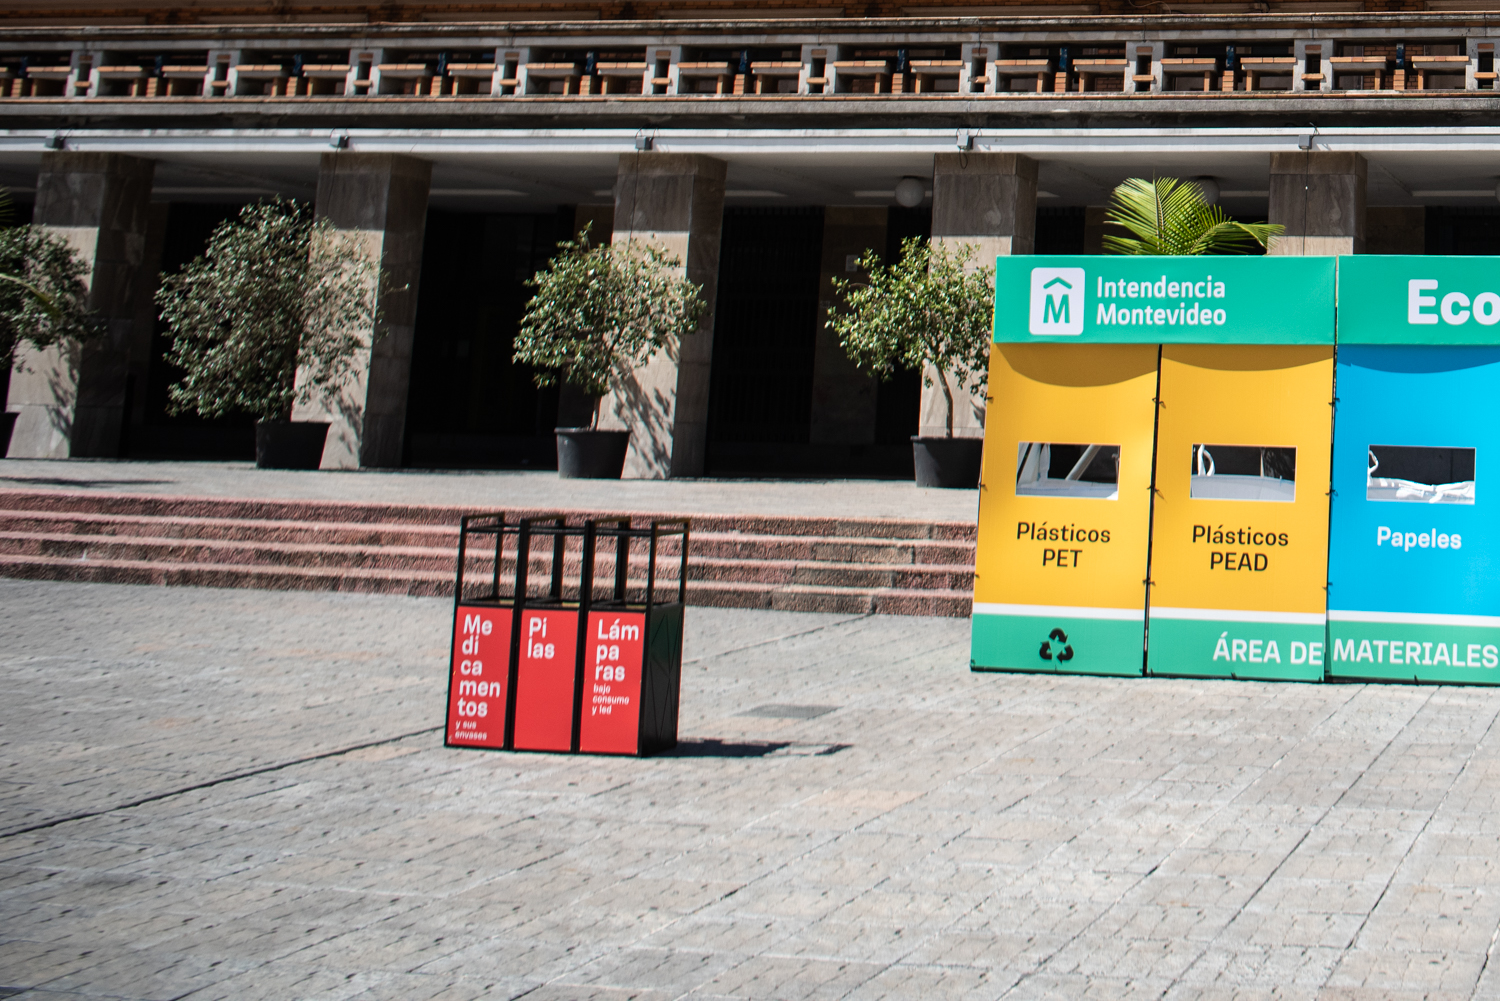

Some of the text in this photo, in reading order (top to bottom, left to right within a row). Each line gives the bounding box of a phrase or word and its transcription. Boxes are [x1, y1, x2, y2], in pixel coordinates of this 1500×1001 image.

[1096, 275, 1226, 301] Intendencia
[1096, 302, 1227, 327] Montevideo
[1015, 520, 1112, 545] Plásticos
[1191, 524, 1290, 548] Plásticos
[1376, 525, 1463, 552] Papeles
[1041, 549, 1083, 569] PET
[1209, 551, 1269, 573] PEAD
[463, 614, 493, 635] Me
[528, 616, 547, 638] Pi
[597, 617, 640, 641] Lám
[461, 634, 479, 656] di
[527, 639, 556, 659] las
[596, 644, 620, 664] pa
[1212, 631, 1282, 664] ÁREA
[1290, 640, 1323, 666] DE
[1332, 639, 1500, 670] MATERIALES
[460, 659, 483, 676] ca
[594, 665, 626, 682] ras
[458, 680, 501, 698] men
[593, 683, 611, 694] bajo
[457, 697, 488, 718] tos
[591, 704, 612, 716] y led
[592, 695, 630, 705] consumo
[454, 730, 488, 741] envases
[455, 720, 477, 730] y sus
